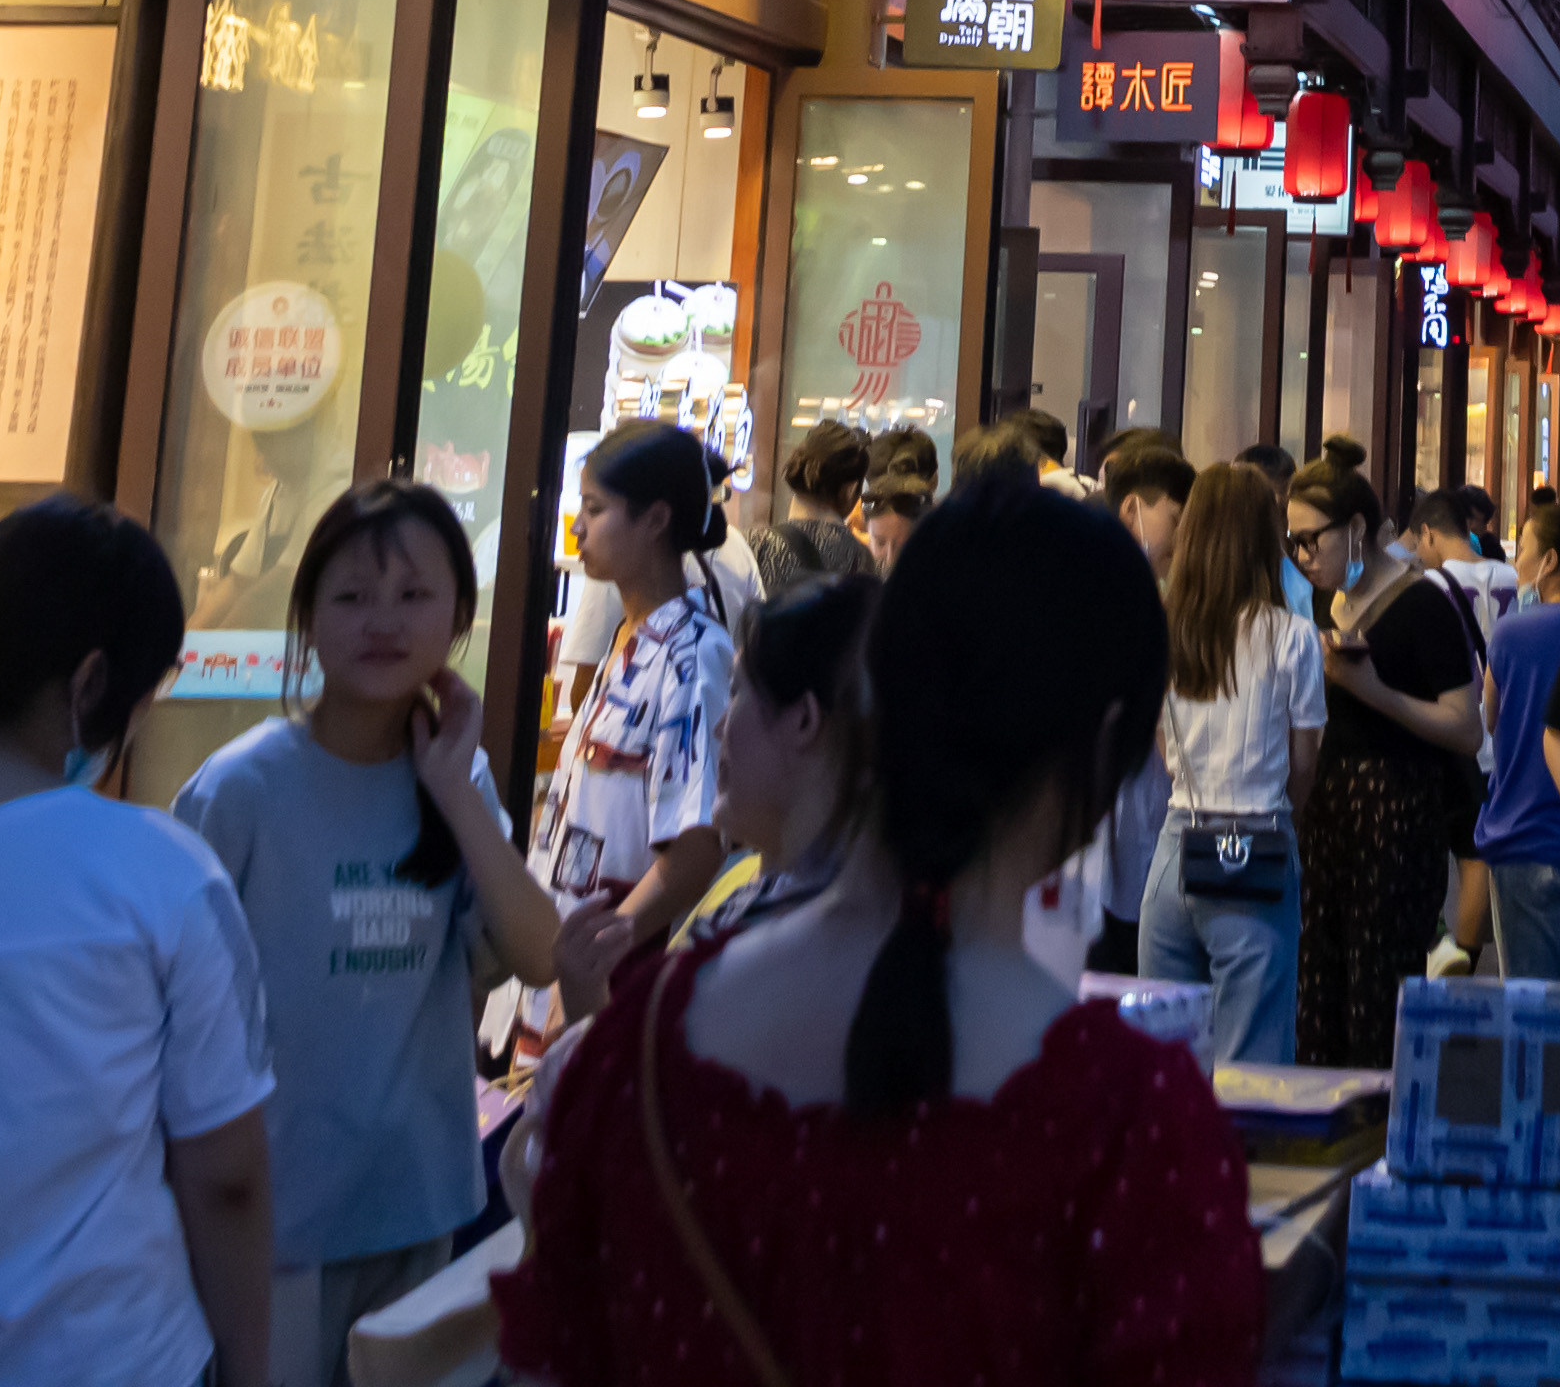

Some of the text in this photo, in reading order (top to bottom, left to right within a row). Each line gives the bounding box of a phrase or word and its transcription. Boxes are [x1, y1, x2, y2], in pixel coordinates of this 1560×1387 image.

[1081, 61, 1195, 113] 譚木匠
[330, 889, 434, 921] WORKING
[351, 916, 411, 948] HARD
[329, 945, 428, 976] ENOUGH?
